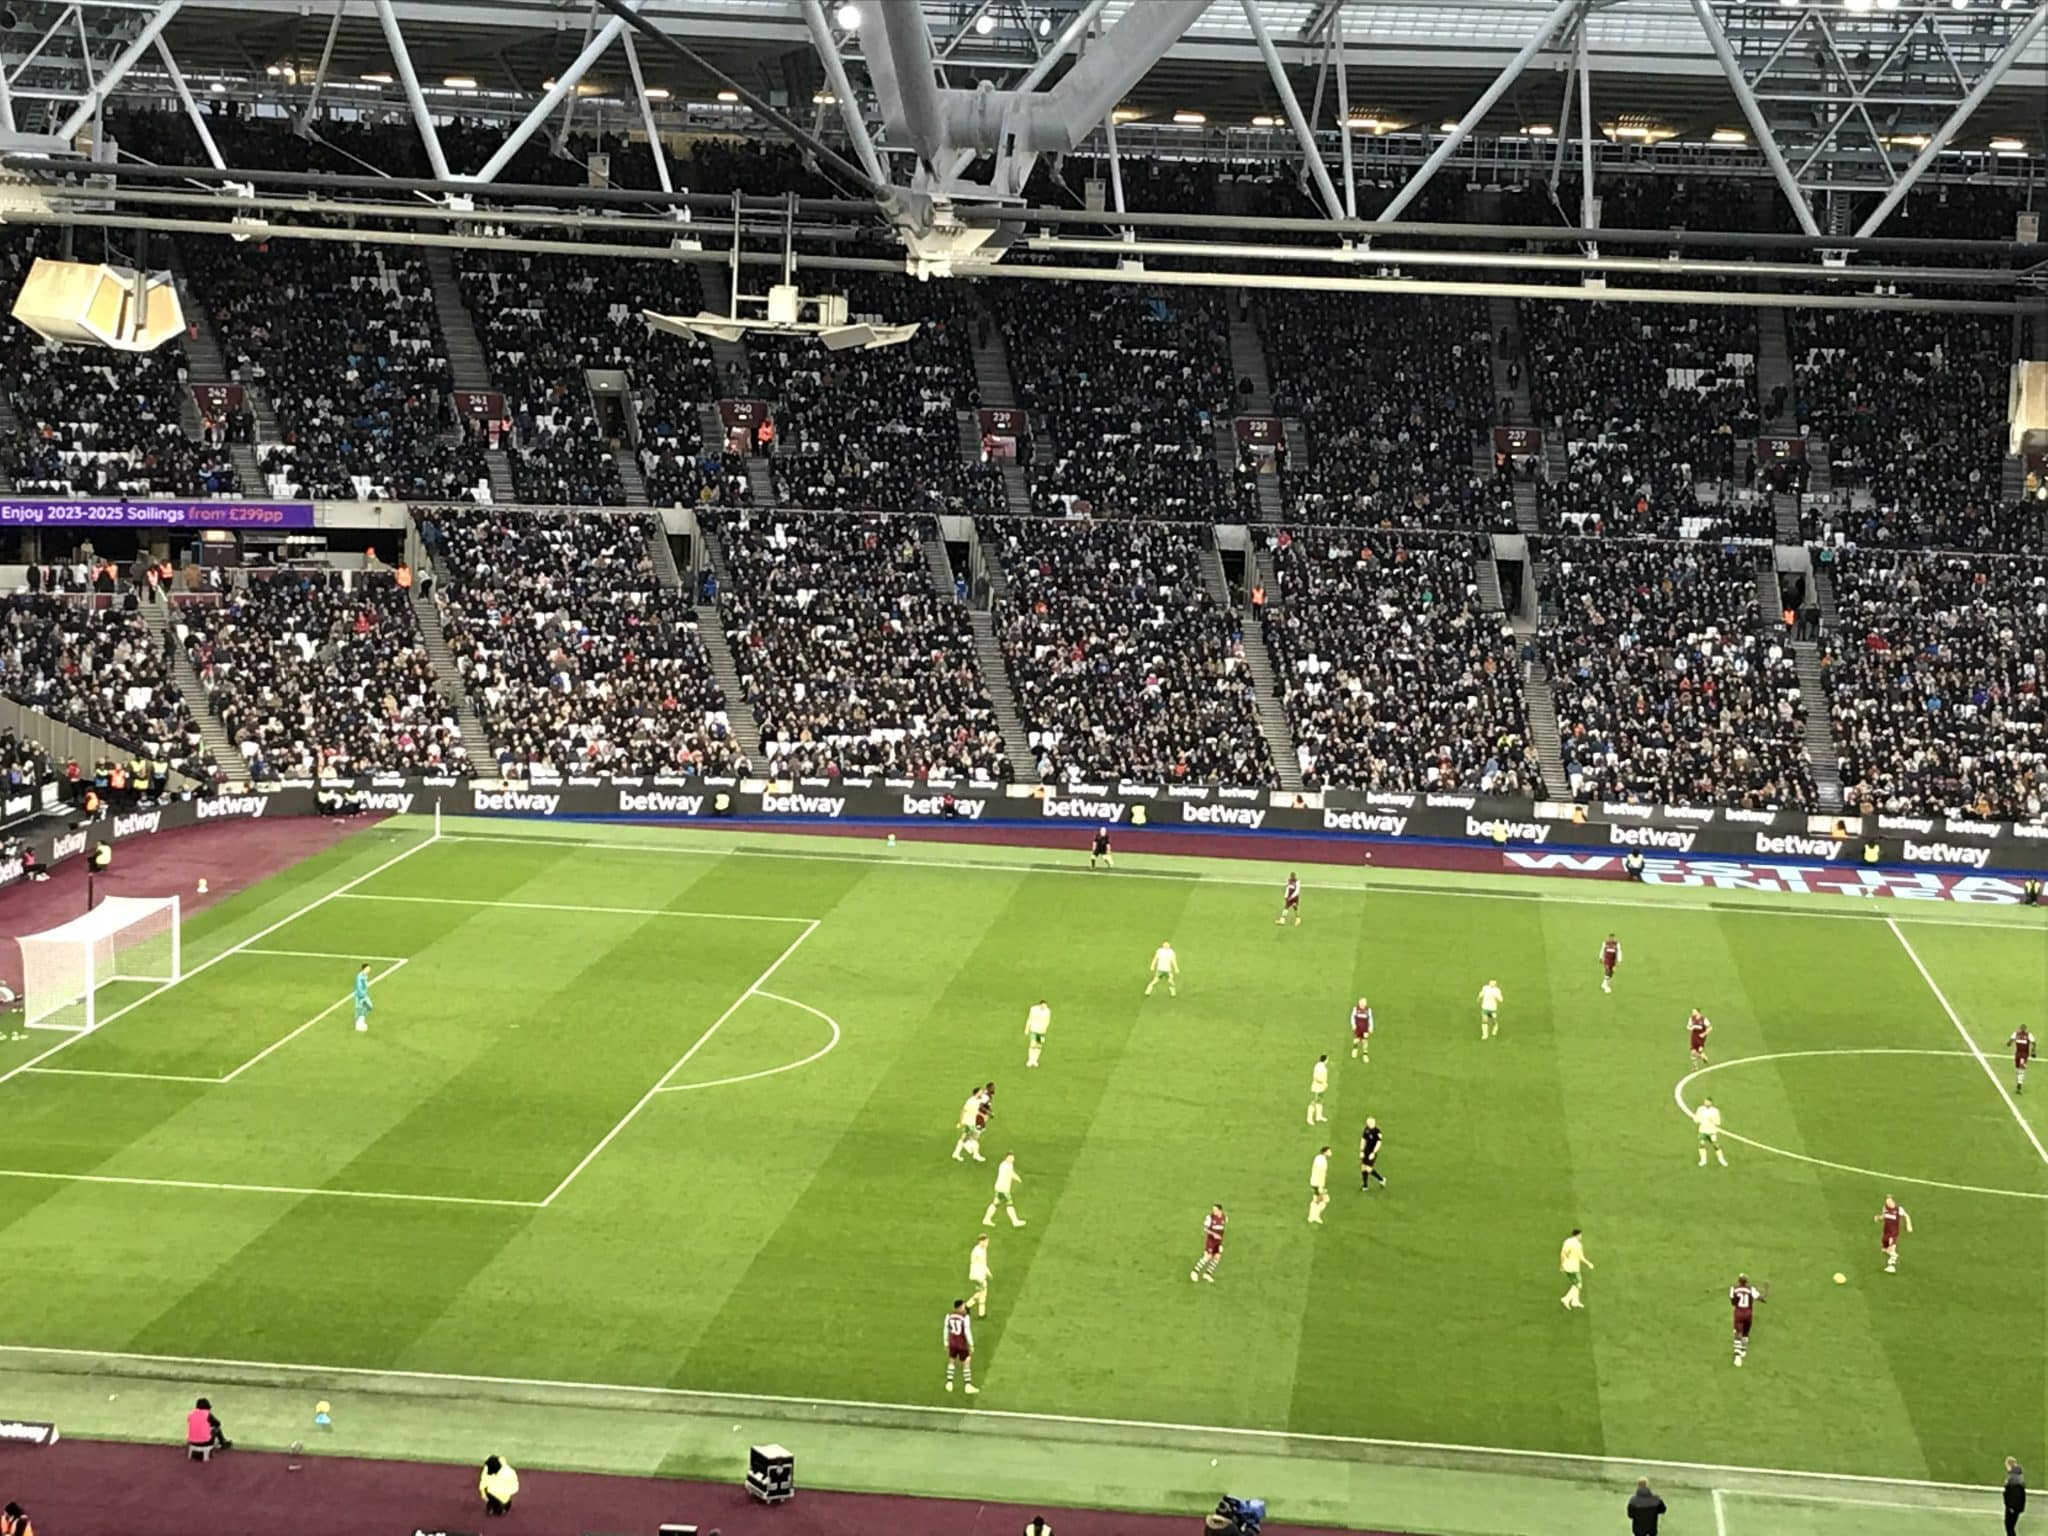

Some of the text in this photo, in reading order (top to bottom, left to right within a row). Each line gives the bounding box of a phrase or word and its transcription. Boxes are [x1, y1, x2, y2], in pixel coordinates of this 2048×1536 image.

[734, 404, 753, 413] 240
[1, 506, 43, 522] Enjoy
[127, 507, 184, 522] Sailings
[188, 507, 225, 520] from
[229, 508, 283, 522] £299pp
[196, 795, 269, 818] betway
[474, 789, 560, 815] betway
[619, 790, 704, 815] betway
[761, 793, 846, 817] betway
[1042, 796, 1126, 823] betway
[1182, 801, 1266, 829] betway
[113, 810, 162, 838] betway
[1323, 808, 1408, 836] betway
[1466, 815, 1551, 844] beway
[1878, 814, 1934, 834] betway
[1945, 818, 2001, 838] betway
[1610, 823, 1697, 852] betway
[1755, 831, 1842, 861] betway
[1903, 840, 1991, 869] betway
